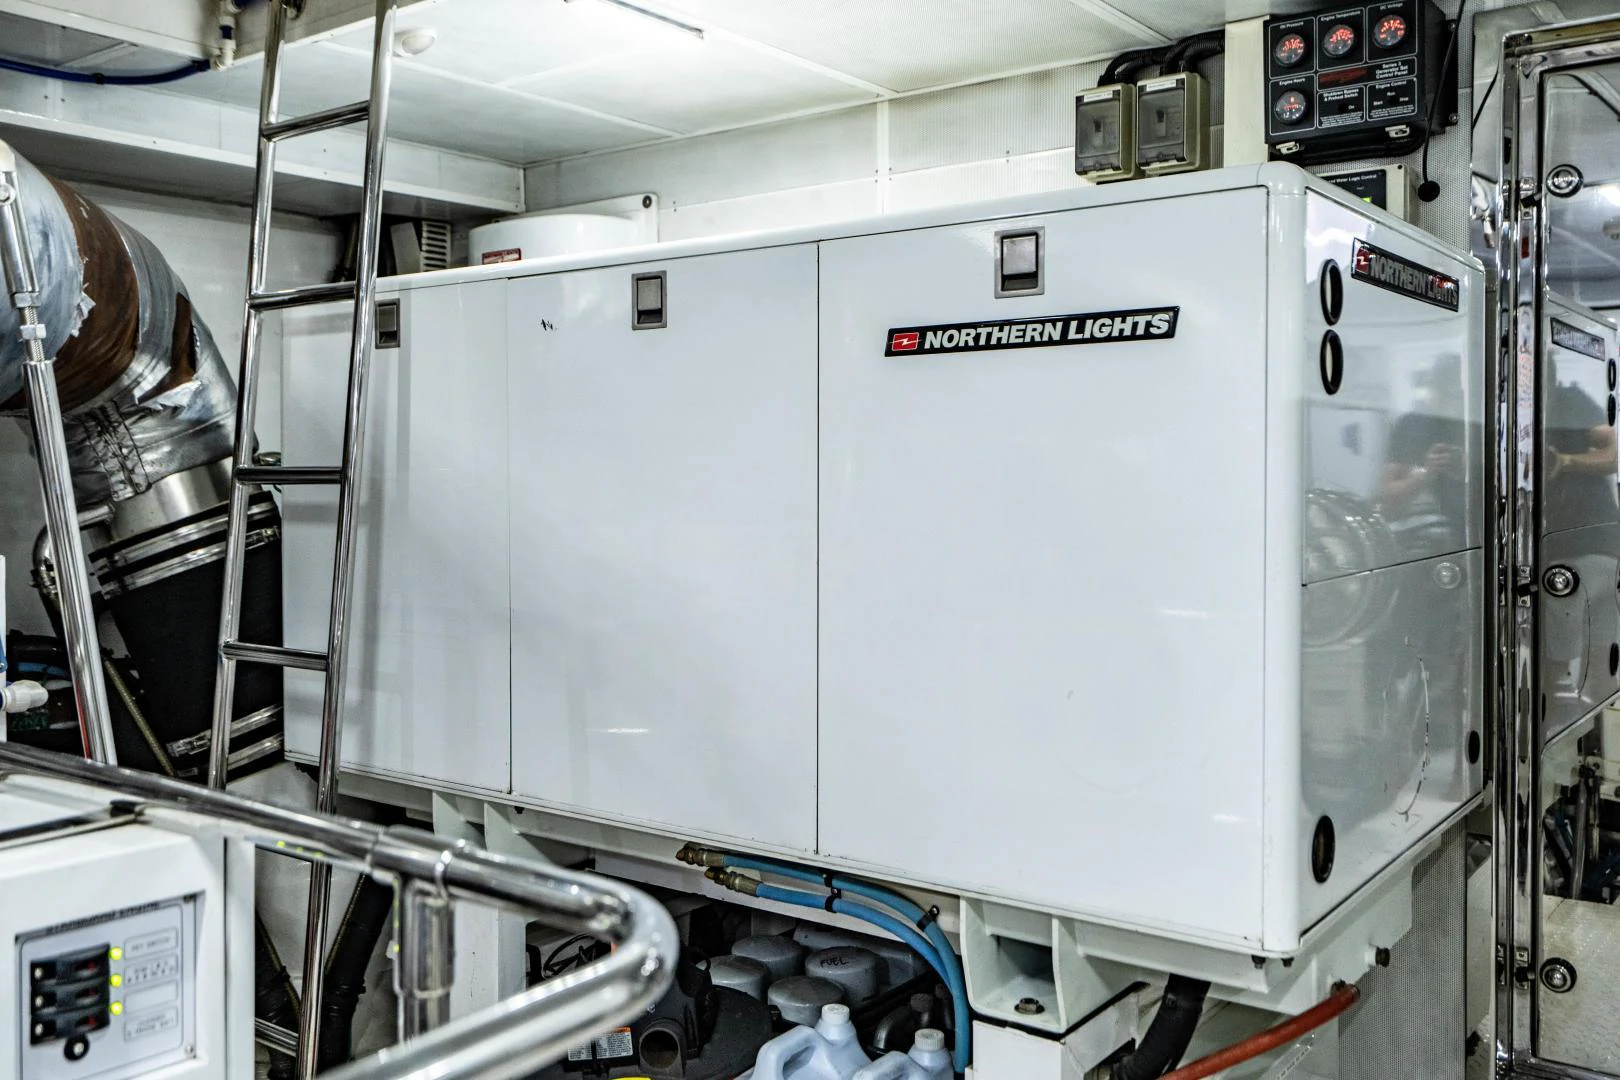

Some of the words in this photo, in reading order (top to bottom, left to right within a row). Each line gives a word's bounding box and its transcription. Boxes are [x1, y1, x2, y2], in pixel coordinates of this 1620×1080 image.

[1335, 10, 1361, 19] Temperature
[1375, 67, 1399, 75] Generator
[1394, 69, 1408, 77] Panel
[1323, 90, 1343, 98] Shutdown
[1370, 253, 1427, 292] NORTHERN
[923, 320, 1062, 349] NORTHERN
[1066, 313, 1171, 340] LIGHTS
